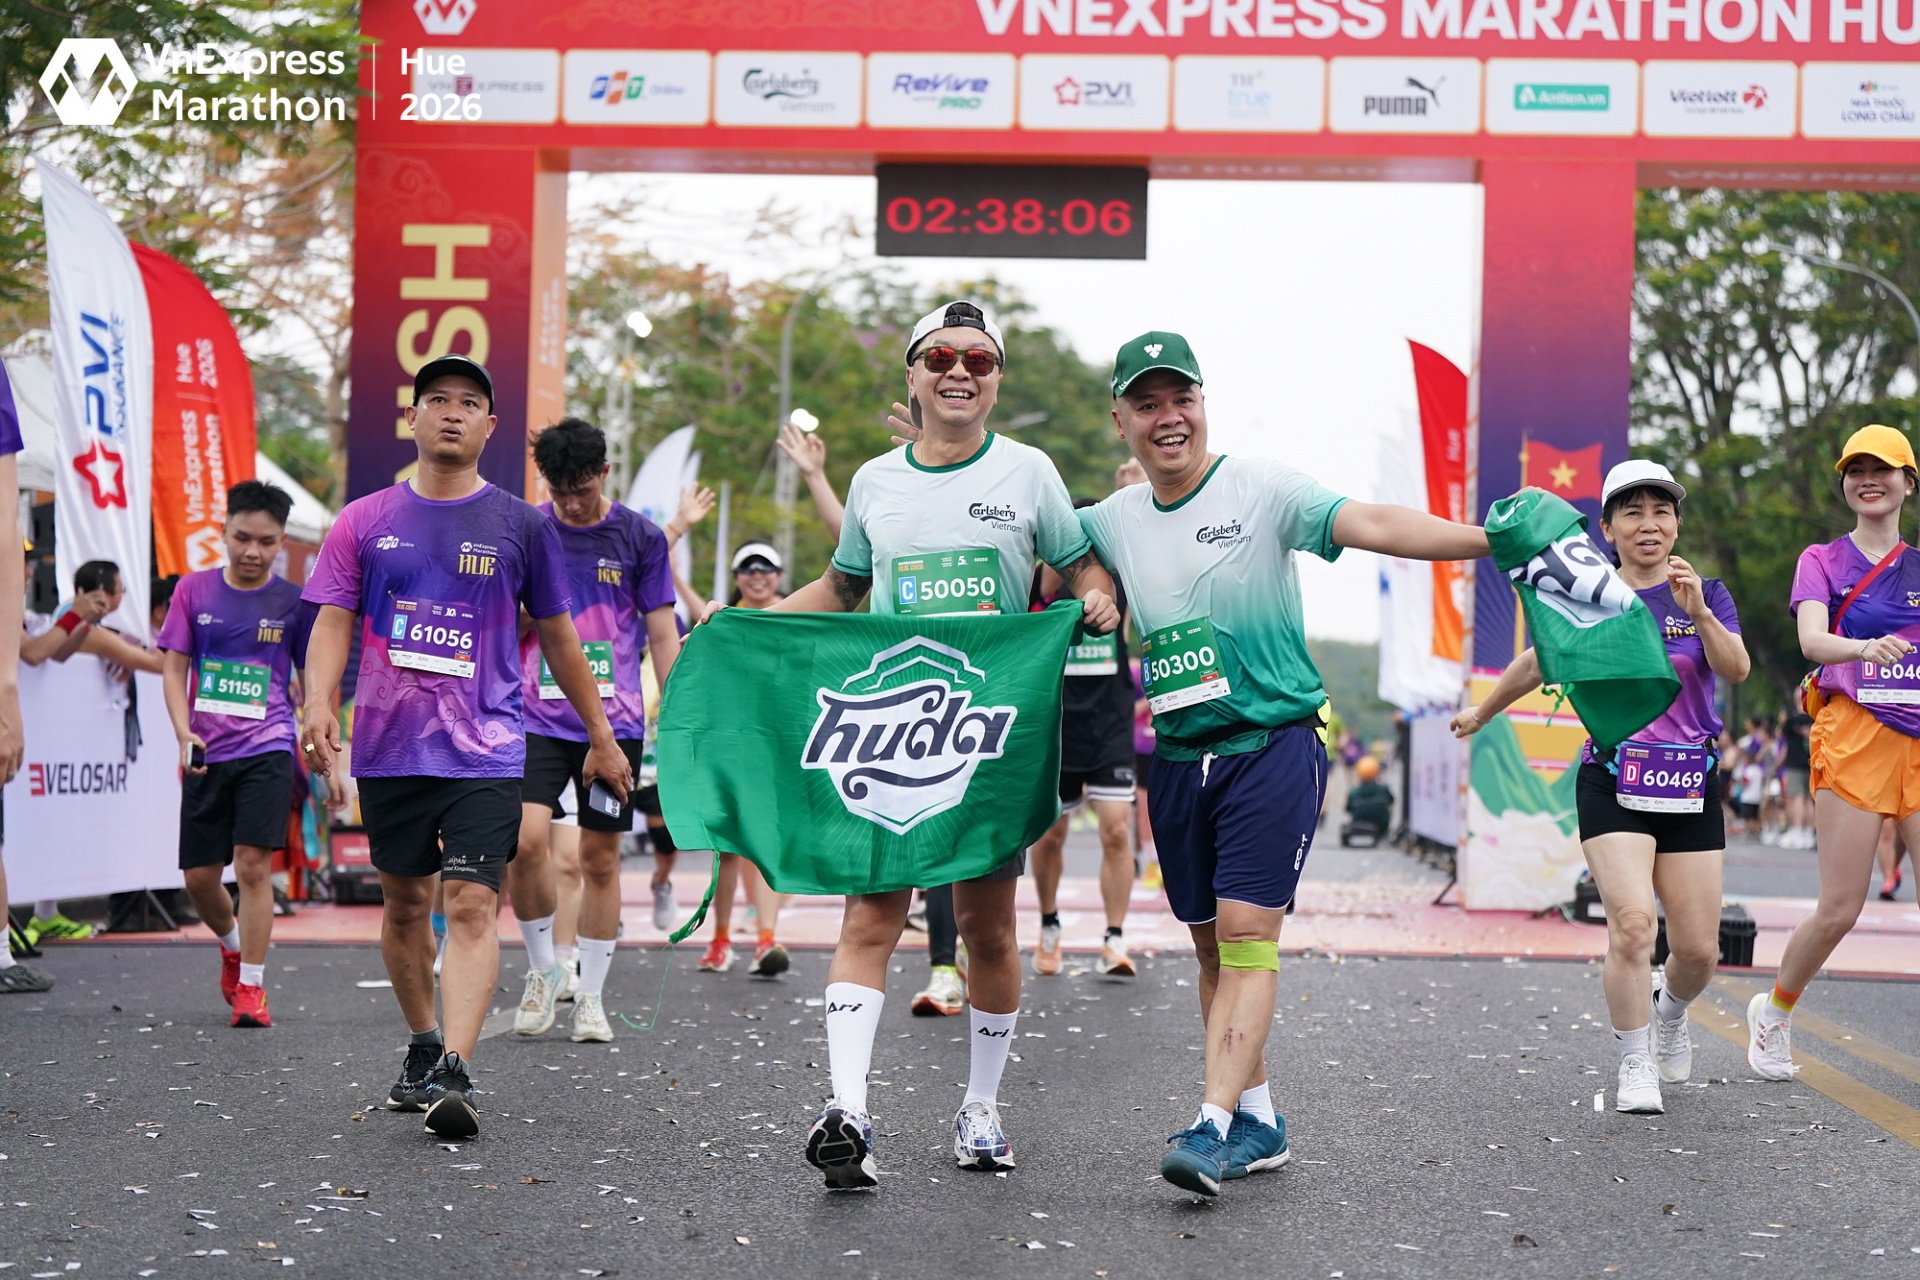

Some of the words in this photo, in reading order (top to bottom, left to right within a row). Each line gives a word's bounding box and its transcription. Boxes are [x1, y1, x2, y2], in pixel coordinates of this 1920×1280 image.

[975, 0, 1388, 40] VNEXPRESS
[1400, 0, 1811, 43] MARATHON
[742, 68, 820, 100] Carlsberg
[1084, 82, 1133, 98] PVI
[938, 96, 983, 110] PRO
[1364, 95, 1428, 116] PUMA
[885, 196, 1134, 237] 02:38:06
[80, 312, 112, 436] PVI
[176, 343, 193, 384] Hue
[196, 338, 219, 389] 2026
[181, 410, 205, 524] VnExpress
[204, 414, 228, 523] Marathon
[968, 502, 1016, 521] Carlsberg
[991, 521, 1023, 534] Vietnam
[1196, 519, 1242, 544] Carlsberg
[458, 554, 497, 576] HUE
[901, 581, 914, 600] C
[920, 577, 996, 600] 50050
[394, 618, 405, 636] C
[410, 623, 473, 650] 61056
[1151, 646, 1216, 681] 50300
[203, 675, 212, 690] A
[218, 678, 263, 698] 51150
[804, 684, 1011, 764] huda
[1626, 765, 1637, 781] D
[1643, 769, 1704, 788] 60469
[827, 1001, 863, 1015] Ari
[977, 1026, 1010, 1038] Ari
